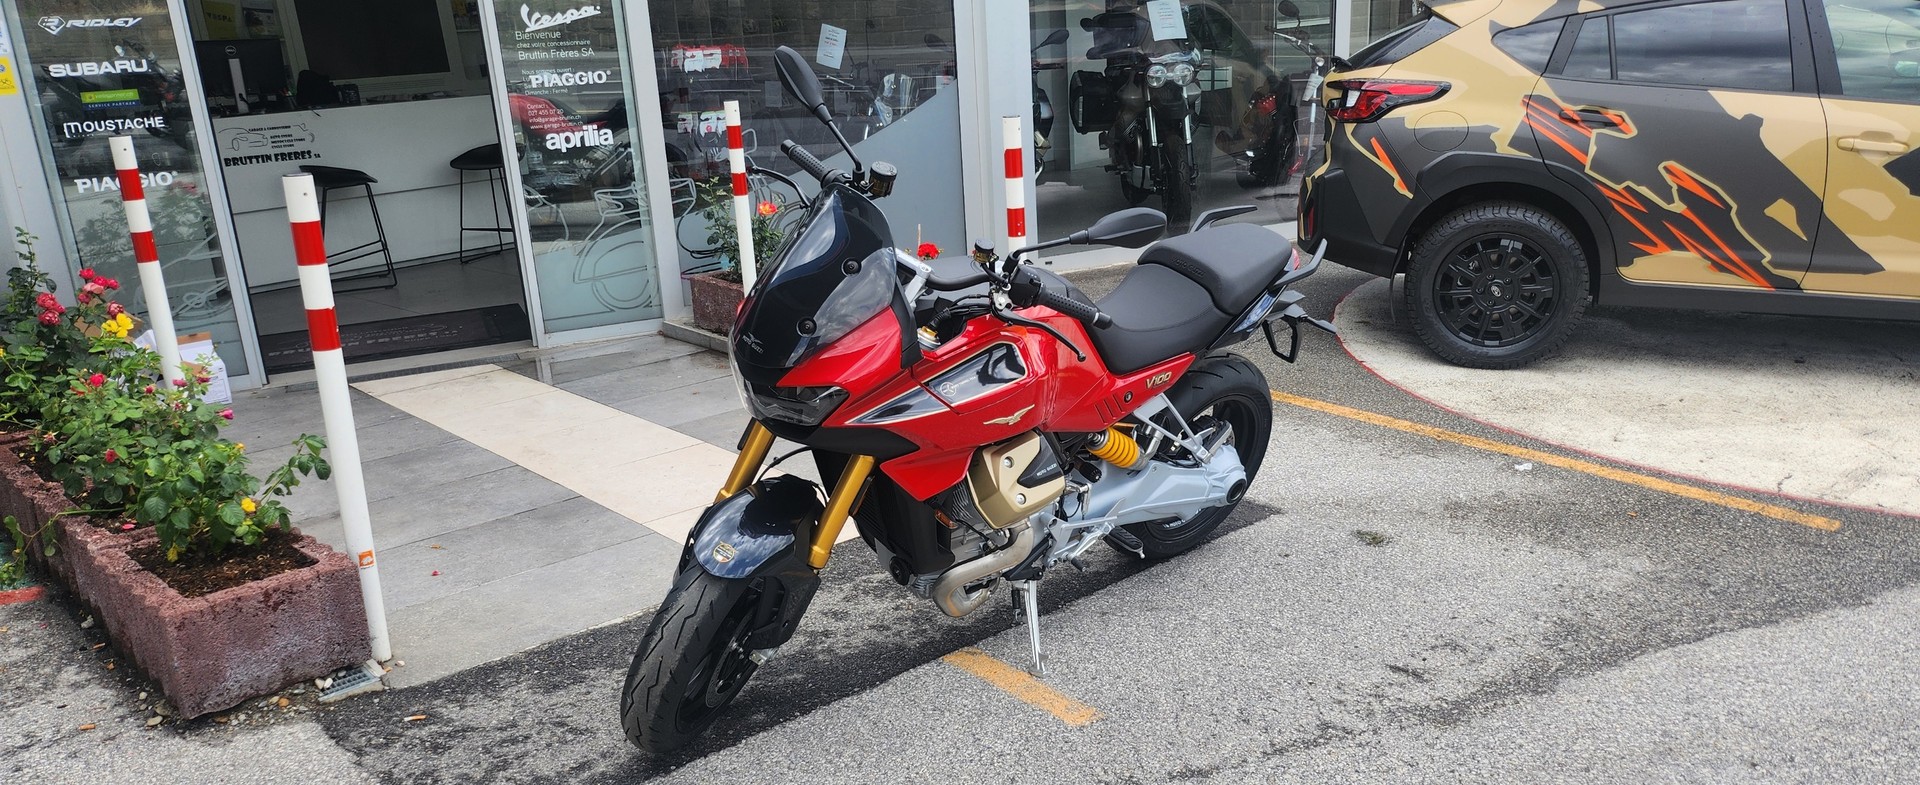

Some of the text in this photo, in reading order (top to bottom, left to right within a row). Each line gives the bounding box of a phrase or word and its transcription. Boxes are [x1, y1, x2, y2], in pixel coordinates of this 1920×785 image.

[65, 17, 142, 28] RIDLEY
[520, 3, 601, 32] Vespa
[515, 30, 561, 40] Bienvenue
[547, 39, 590, 47] concessionnaire
[518, 48, 595, 60] Bruttin Frères SA
[48, 59, 148, 78] SUBARU
[529, 70, 606, 88] PIAGGIO
[546, 124, 614, 152] aprilia
[224, 154, 272, 167] BRUTTIN
[274, 150, 312, 162] FRERES
[1146, 372, 1172, 388] V100
